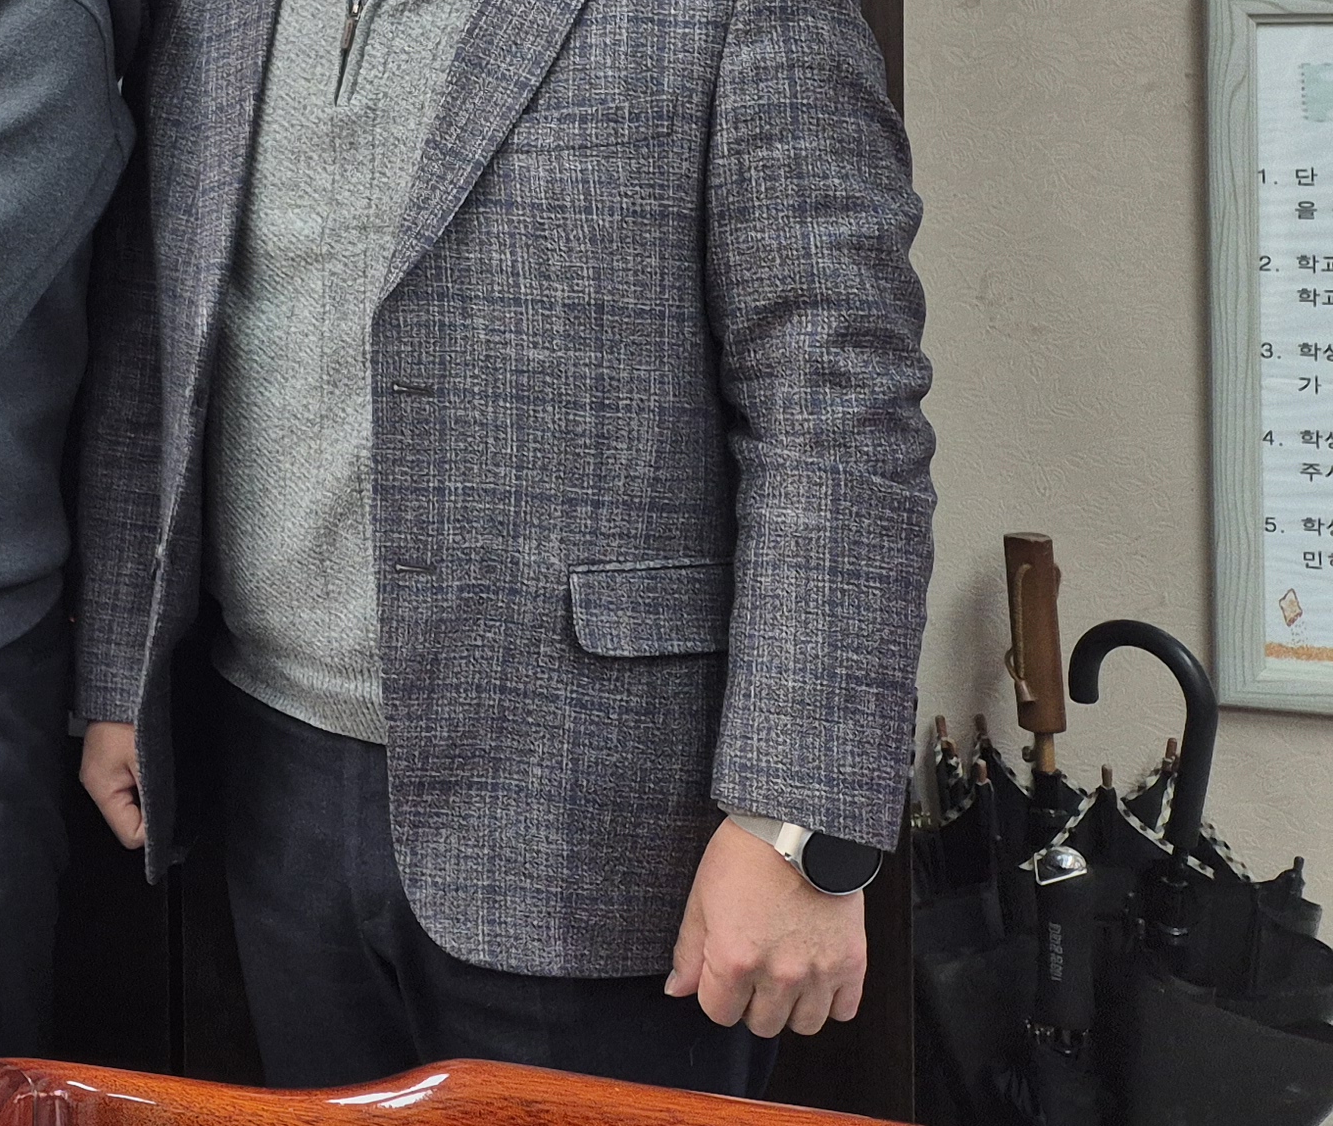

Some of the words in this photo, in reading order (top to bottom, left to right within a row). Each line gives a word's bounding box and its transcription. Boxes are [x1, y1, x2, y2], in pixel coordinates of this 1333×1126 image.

[1258, 255, 1279, 273] 2.
[1260, 341, 1281, 359] 3.
[1262, 429, 1283, 446] 4.
[1264, 516, 1285, 534] 5.
